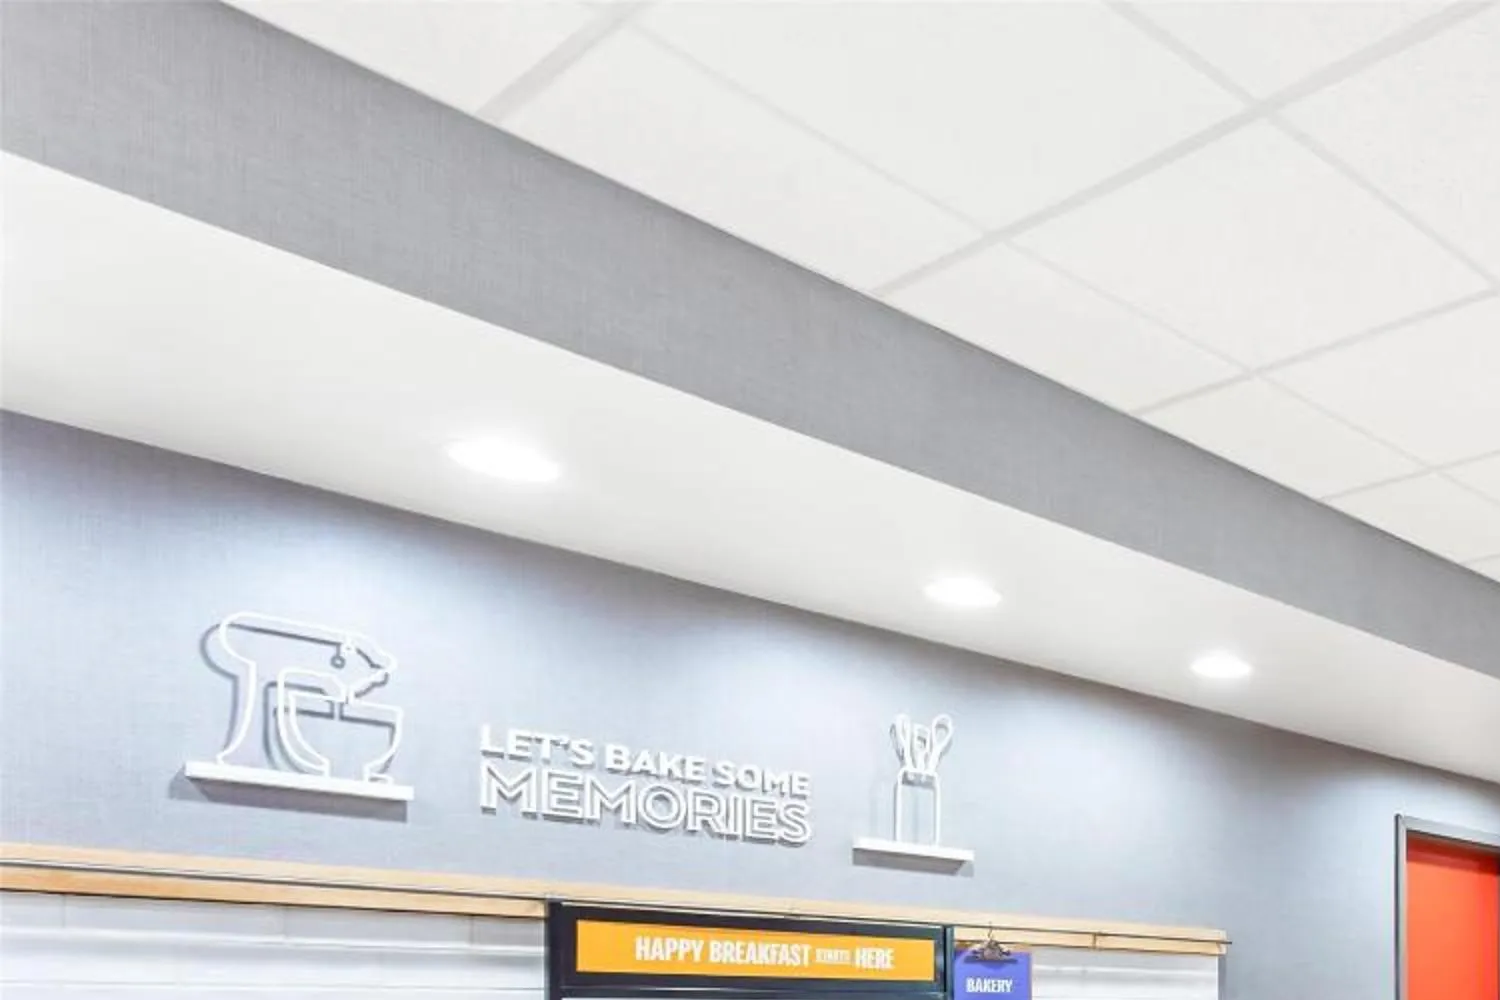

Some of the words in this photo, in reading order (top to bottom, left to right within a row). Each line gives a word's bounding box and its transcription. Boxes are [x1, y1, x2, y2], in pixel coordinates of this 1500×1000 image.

[481, 724, 594, 767] LET'S
[604, 743, 706, 783] BAKE
[713, 759, 813, 798] SOME
[480, 760, 813, 846] MEMORIES
[635, 936, 704, 962] HAPPY
[709, 940, 811, 967] BREAKFAST
[854, 947, 894, 969] HERE
[966, 977, 1013, 992] BAKERY
